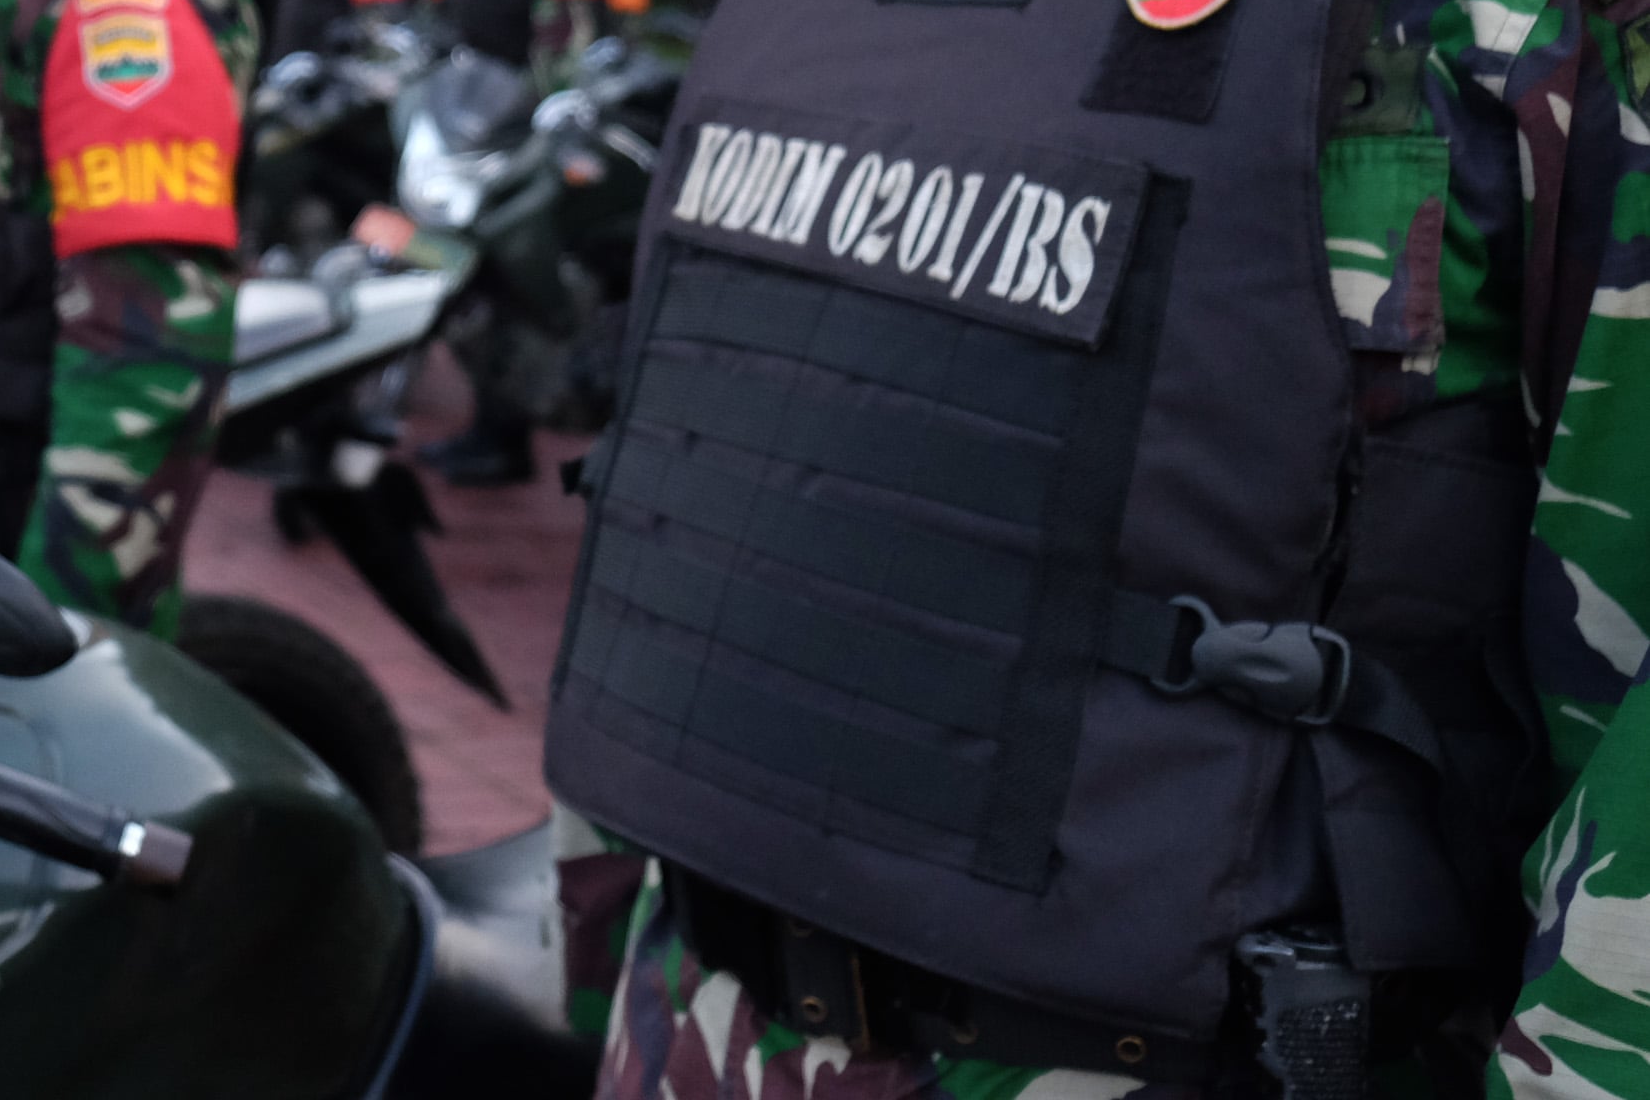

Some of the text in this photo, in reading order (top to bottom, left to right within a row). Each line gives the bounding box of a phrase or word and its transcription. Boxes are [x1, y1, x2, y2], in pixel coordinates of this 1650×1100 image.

[49, 137, 227, 222] ABINS
[671, 123, 1112, 315] KODIM 0201/BS
